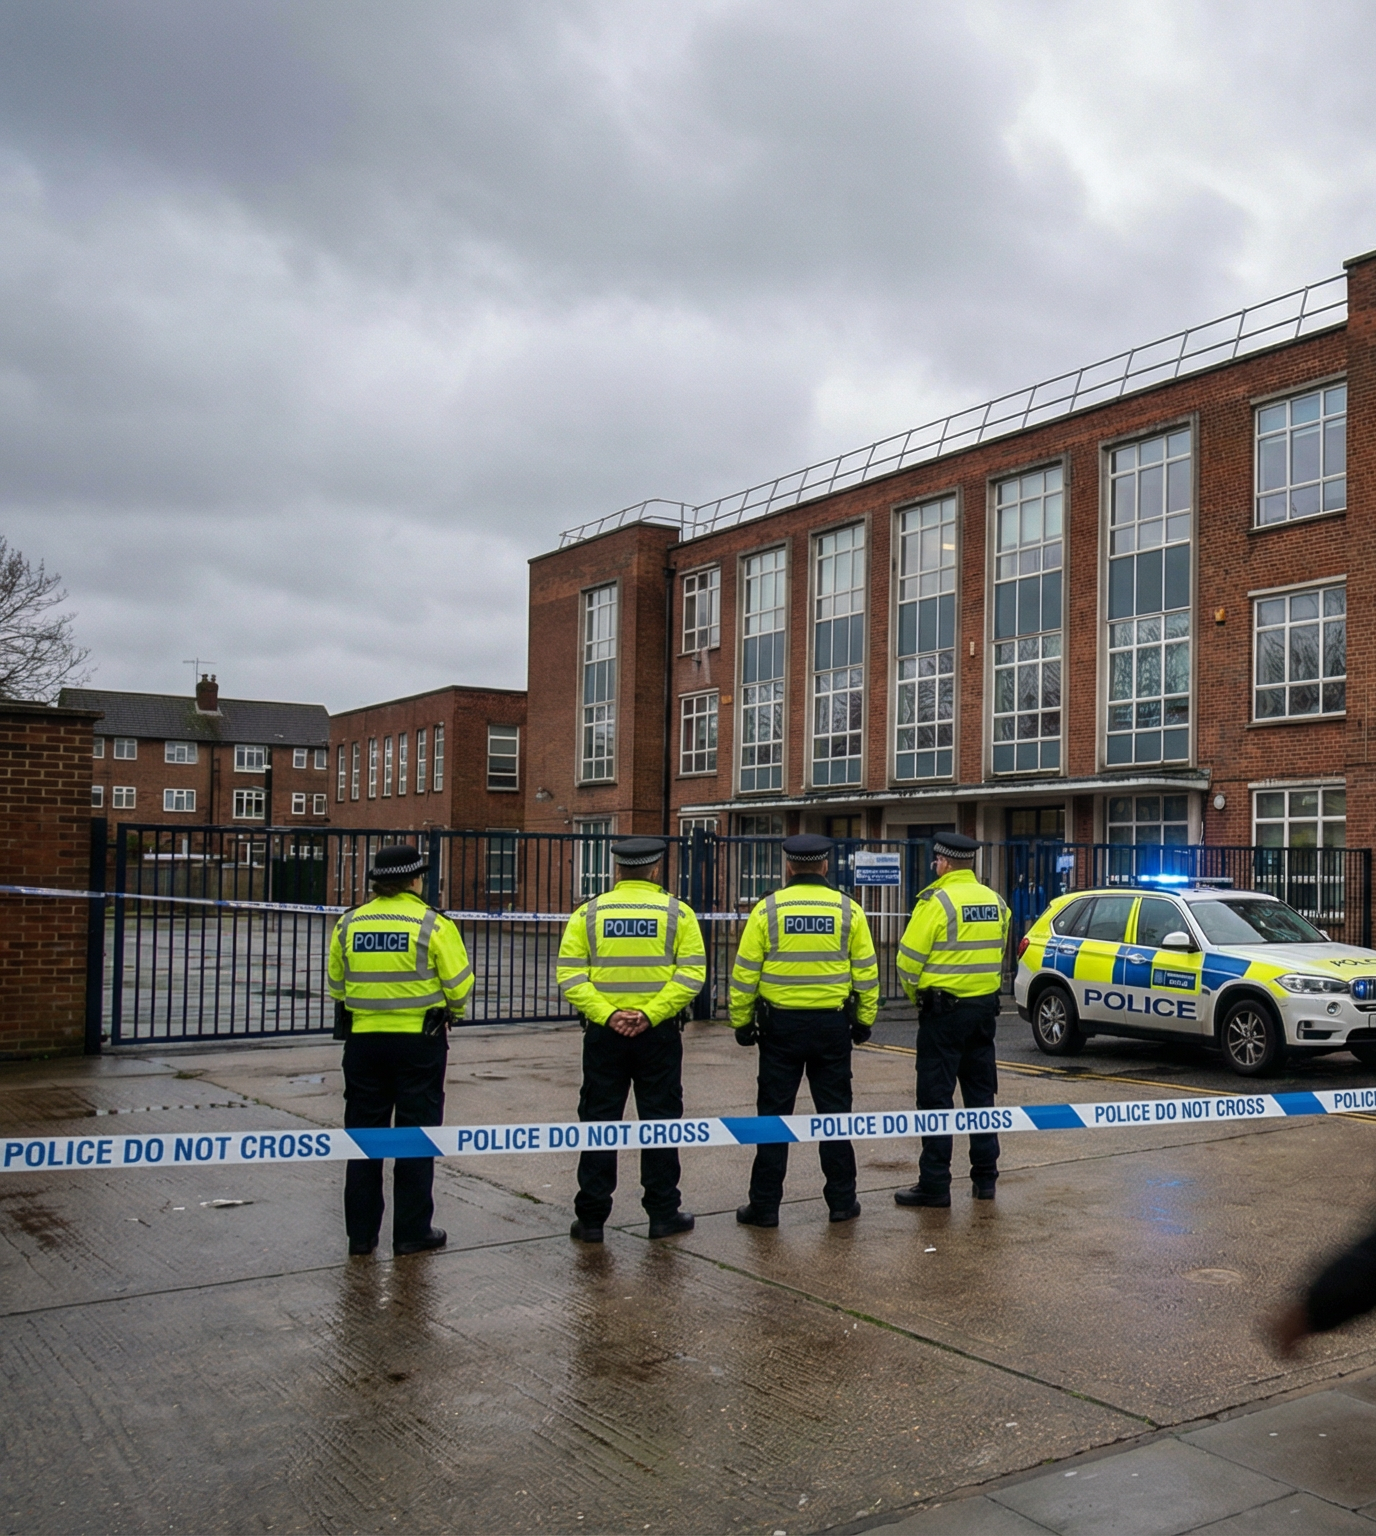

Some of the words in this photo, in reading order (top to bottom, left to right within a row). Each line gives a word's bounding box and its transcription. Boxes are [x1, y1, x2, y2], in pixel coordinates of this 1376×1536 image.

[605, 920, 656, 937] POLICE
[786, 917, 833, 932] POLICE
[354, 933, 408, 951] POLICE
[1084, 988, 1197, 1020] POLICE
[810, 1115, 877, 1137] POLICE
[883, 1114, 908, 1134] DO
[914, 1113, 949, 1133] NOT
[955, 1110, 1012, 1131] CROSS
[1094, 1103, 1150, 1123] POLICE
[1155, 1102, 1177, 1121] DO
[1182, 1100, 1211, 1119] NOT
[1216, 1098, 1265, 1117] CROSS
[458, 1128, 540, 1151] POLICE
[549, 1126, 580, 1148] DO
[588, 1124, 631, 1147] NOT
[639, 1122, 710, 1145] CROSS
[3, 1140, 113, 1167] POLICE
[123, 1138, 164, 1164] DO
[174, 1136, 231, 1162] NOT
[240, 1133, 331, 1160] CROSS
